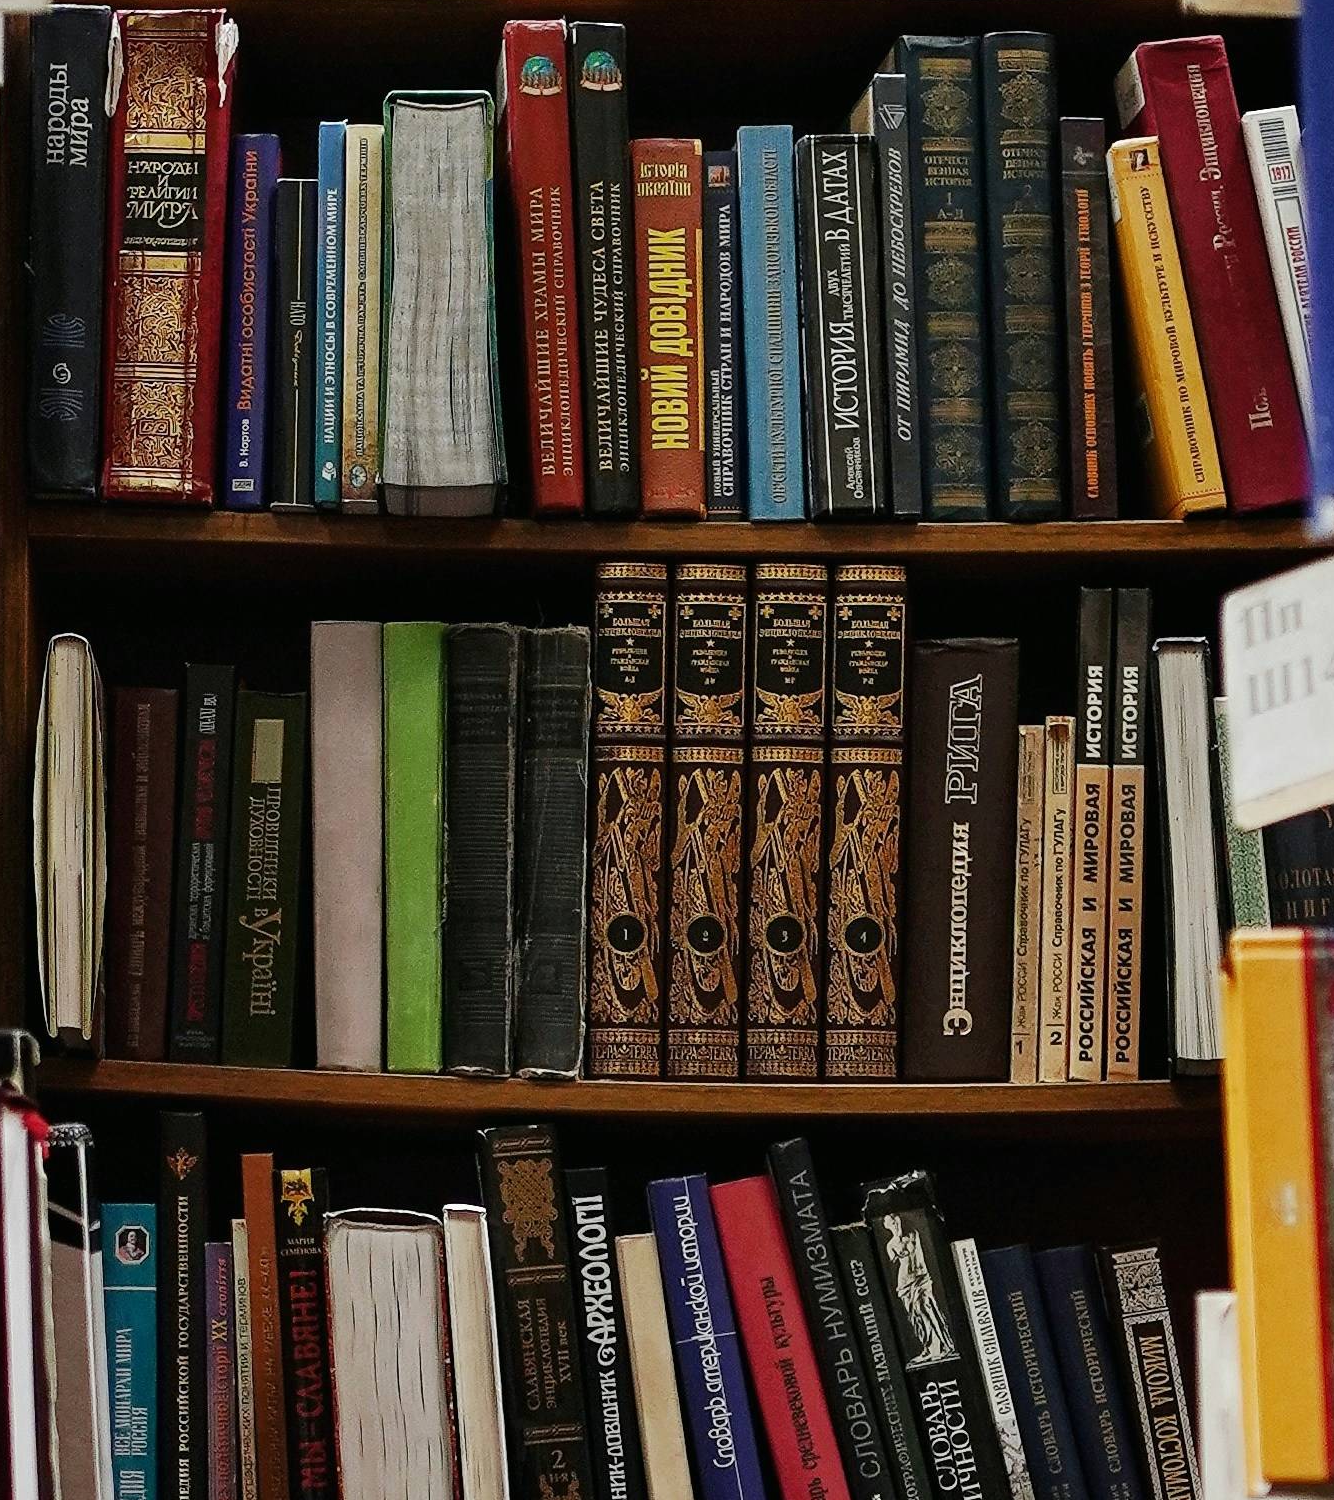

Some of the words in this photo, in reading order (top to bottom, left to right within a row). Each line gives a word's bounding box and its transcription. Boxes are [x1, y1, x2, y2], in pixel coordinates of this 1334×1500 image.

[45, 62, 69, 164] народы
[69, 96, 91, 167] мира
[127, 186, 197, 200] РЕЛИГИИ
[128, 161, 198, 175] НАРОДЫ
[822, 148, 854, 224] ДАТАХ
[1271, 160, 1294, 184] 1917
[126, 200, 199, 228] МИРА
[325, 187, 339, 222] МИРЕ
[527, 186, 545, 243] МИРА
[547, 185, 566, 289] СПРАВОЧНИК
[589, 180, 605, 240] СВЕТА
[608, 181, 623, 284] СПРАВОЧНИК
[719, 204, 731, 246] МИРА
[824, 228, 851, 240] В
[885, 146, 906, 278] НЕБОСКРЕБОВ
[1140, 187, 1160, 250] ИСКУССТВУ
[324, 223, 339, 318] СОВРЕМЕННОМ
[530, 250, 549, 322] ХРАМЫ
[591, 246, 608, 322] ЧУДЕСА
[647, 226, 693, 357] ДОВІДНИК
[719, 251, 731, 322] НАРОДОВ
[826, 268, 841, 296] ДВУХ
[1152, 252, 1163, 261] И
[325, 320, 337, 328] В
[890, 280, 909, 310] ДО
[1155, 267, 1174, 322] КУЛЬТУРЕ
[324, 331, 338, 384] ЭТНОСЫ
[719, 327, 731, 336] И
[719, 342, 731, 390] СТРАН
[891, 317, 912, 411] ПИРАМИД
[1165, 325, 1185, 383] МИРОВОЙ
[324, 386, 336, 395] И
[532, 328, 557, 476] ВЕЛИЧАЙШИЕ
[551, 294, 575, 477] ЭНЦИКЛОПЕДИЧЕСКИЙ
[591, 329, 613, 471] ВЕЛИЧАЙШИЕ
[610, 290, 630, 472] ЭНЦИКЛОПЕДИЧЕСКИЙ
[640, 364, 689, 449] НОВИЙ
[829, 320, 861, 430] ИСТОРИЯ
[1178, 385, 1190, 403] ПО
[323, 397, 336, 443] НАЦИИ
[721, 393, 733, 496] СПРАВОЧНИК
[896, 415, 912, 441] ОТ
[1182, 405, 1205, 483] СПРАВОЧНИК
[711, 459, 721, 496] НОВЫЙ
[943, 670, 983, 805] РИГА
[1085, 664, 1103, 758] ИСТОРИЯ
[1121, 664, 1139, 758] ИСТОРИЯ
[242, 796, 267, 901] ДУХОВНОСТІ
[259, 786, 283, 900] ПРОВІДНИКИ
[1083, 782, 1099, 882] МИРОВАЯ
[1119, 783, 1136, 883] МИРОВАЯ
[941, 819, 980, 1037] Энциклопедия
[1082, 896, 1096, 911] И
[1118, 896, 1133, 911] И
[233, 905, 283, 1016] Україні
[1075, 927, 1096, 1061] РОССИЙСКАЯ
[1111, 927, 1133, 1062] РОССИЙСКАЯ
[1049, 1030, 1061, 1045] 2
[674, 1194, 703, 1271] истории
[789, 1169, 847, 1341] НУМИЗМАТА
[176, 1194, 189, 1348] ГОСУДАРСТВЕННОСТИ
[114, 1326, 133, 1364] МИРА
[555, 1319, 570, 1346] век
[680, 1274, 724, 1393] американской
[760, 1275, 790, 1351] культуры
[971, 1289, 997, 1355] СИМВОЛІВ
[1010, 1290, 1047, 1405] ИСТОРИЧЕСКИЙ
[1072, 1290, 1108, 1404] ИСТОРИЧЕСКИЙ
[516, 1299, 541, 1411] СЛАВЯНСКАЯ
[535, 1298, 558, 1406] ЭНЦИКЛОПЕДИЯ
[557, 1350, 572, 1383] XVII
[987, 1356, 1010, 1415] СЛОВНИК
[1138, 1335, 1174, 1407] МИКОЛА
[112, 1366, 133, 1429] МОНАРХИ
[129, 1404, 149, 1455] РОССИЯ
[175, 1354, 189, 1452] РОССИЙСКОЙ
[703, 1396, 738, 1468] Словарь
[778, 1358, 820, 1470] средневековой
[834, 1347, 881, 1478] СЛОВАРЬ
[113, 1431, 131, 1456] ВСЕ
[551, 1450, 567, 1469] 2
[919, 1381, 965, 1491] СЛОВАРЬ
[1037, 1410, 1060, 1474] СЛОВАРЬ
[1098, 1409, 1122, 1473] СЛОВАРЬ
